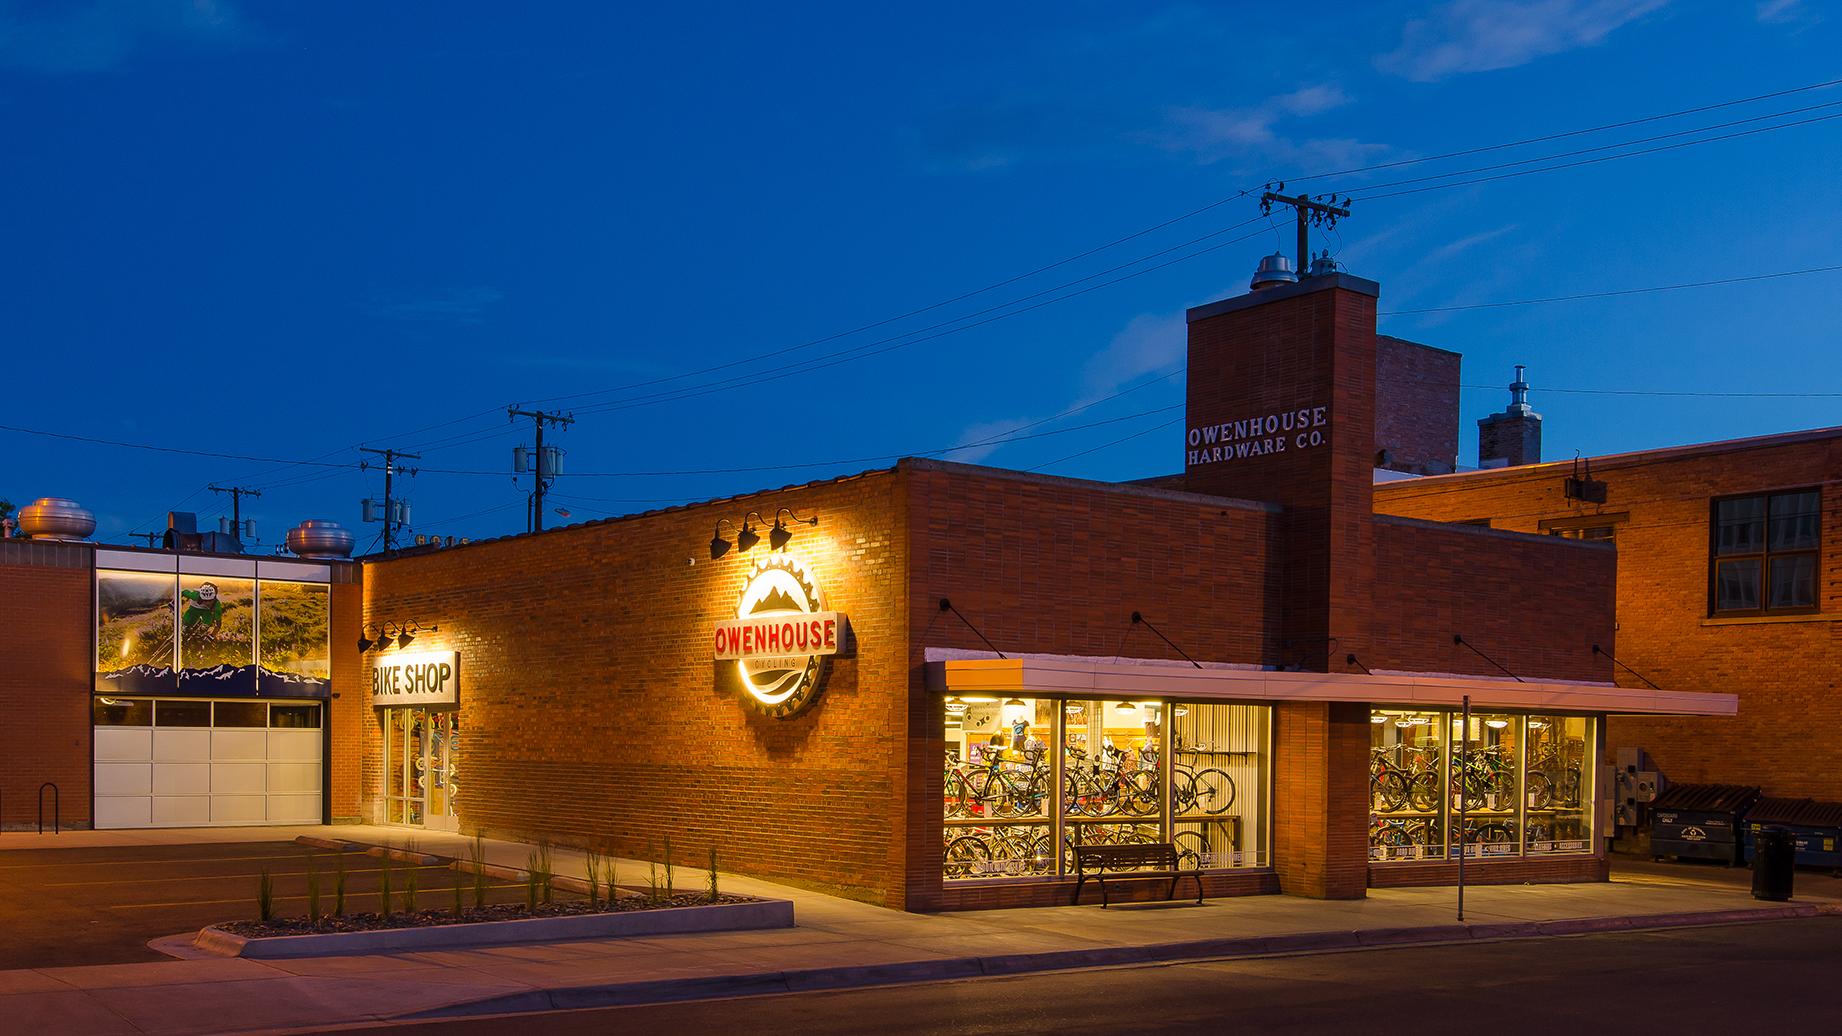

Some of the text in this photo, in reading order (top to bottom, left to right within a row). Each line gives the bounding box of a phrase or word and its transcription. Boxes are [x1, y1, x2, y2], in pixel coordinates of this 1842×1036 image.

[1188, 406, 1327, 447] OWENHOUSE
[1188, 430, 1326, 466] HARDWARE CO.
[715, 620, 836, 655] OWENHOUSE
[372, 662, 451, 696] BIKE SHOP
[754, 658, 796, 669] CYCLING
